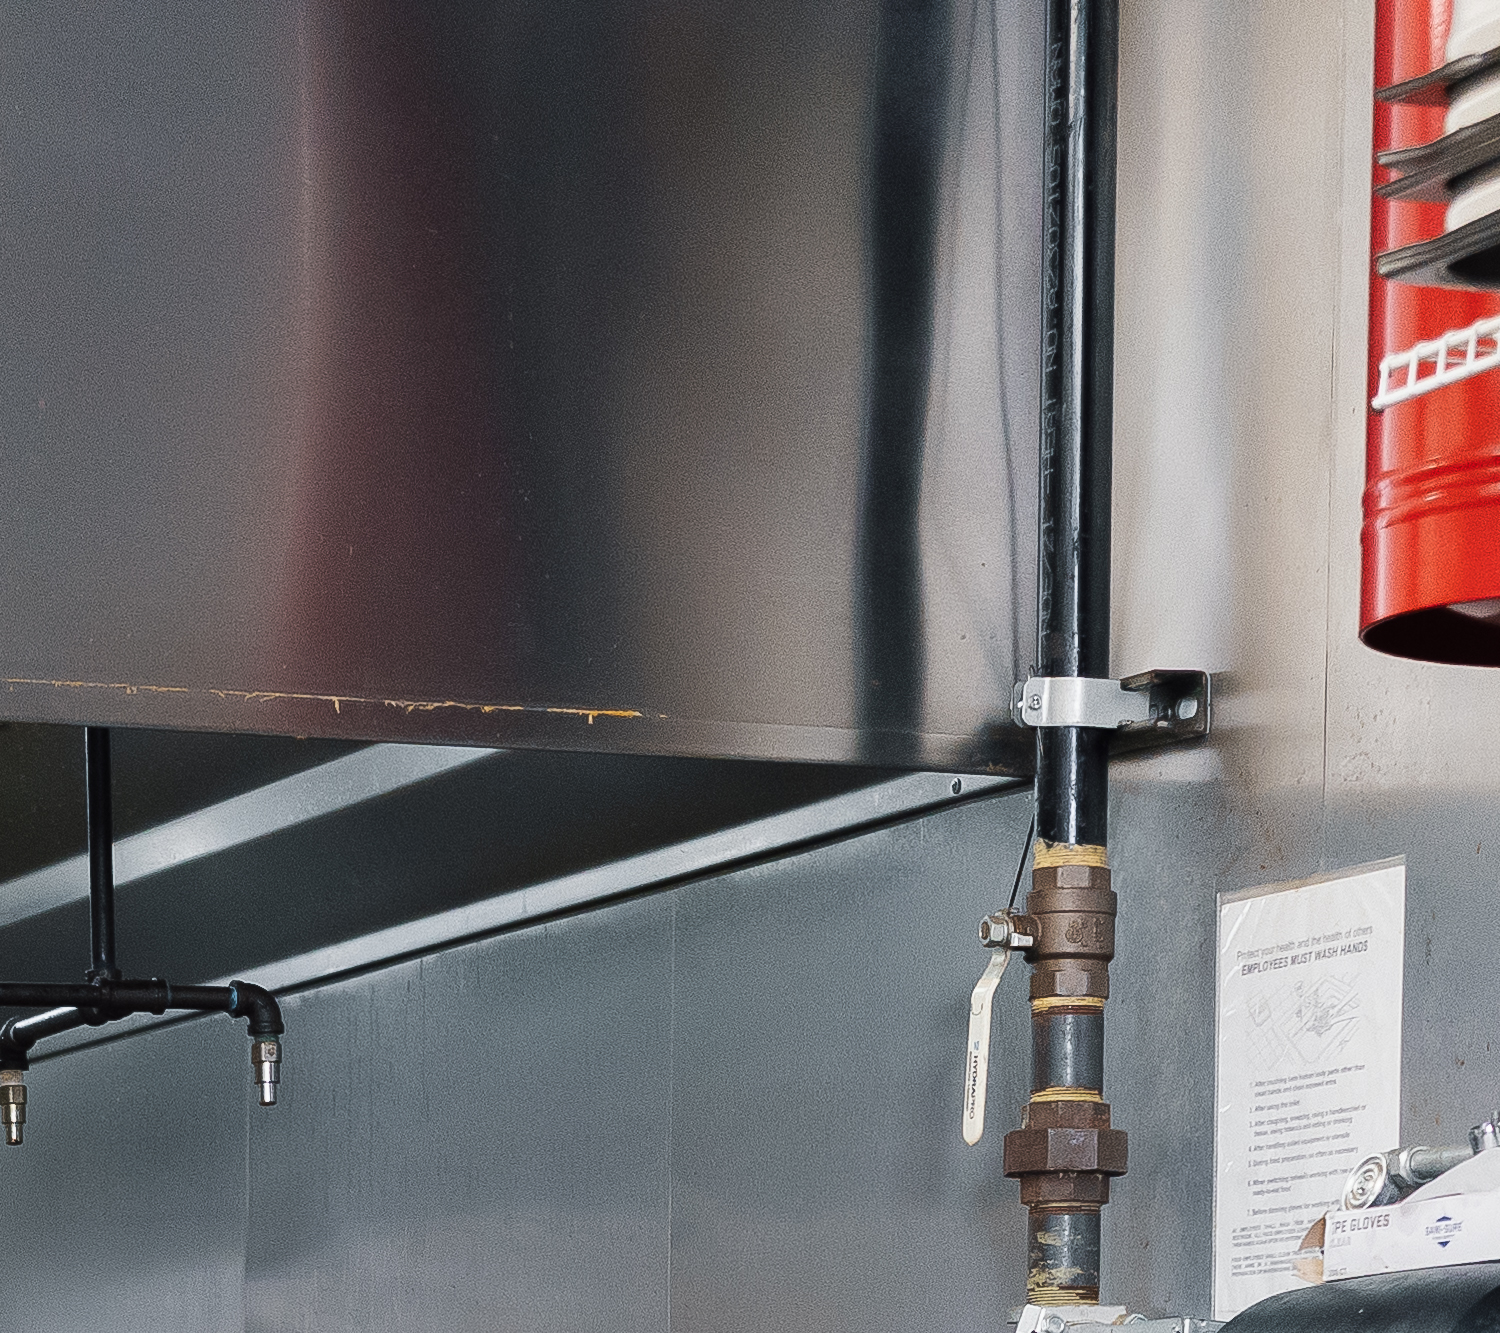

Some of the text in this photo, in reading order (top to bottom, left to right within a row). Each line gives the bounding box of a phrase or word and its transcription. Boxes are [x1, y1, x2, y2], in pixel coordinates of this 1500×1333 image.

[1236, 926, 1373, 961] Protect your health and the health of others
[1241, 939, 1369, 976] EMPLOYEES MUST WASH HANDS
[1350, 1213, 1390, 1232] GLOVES
